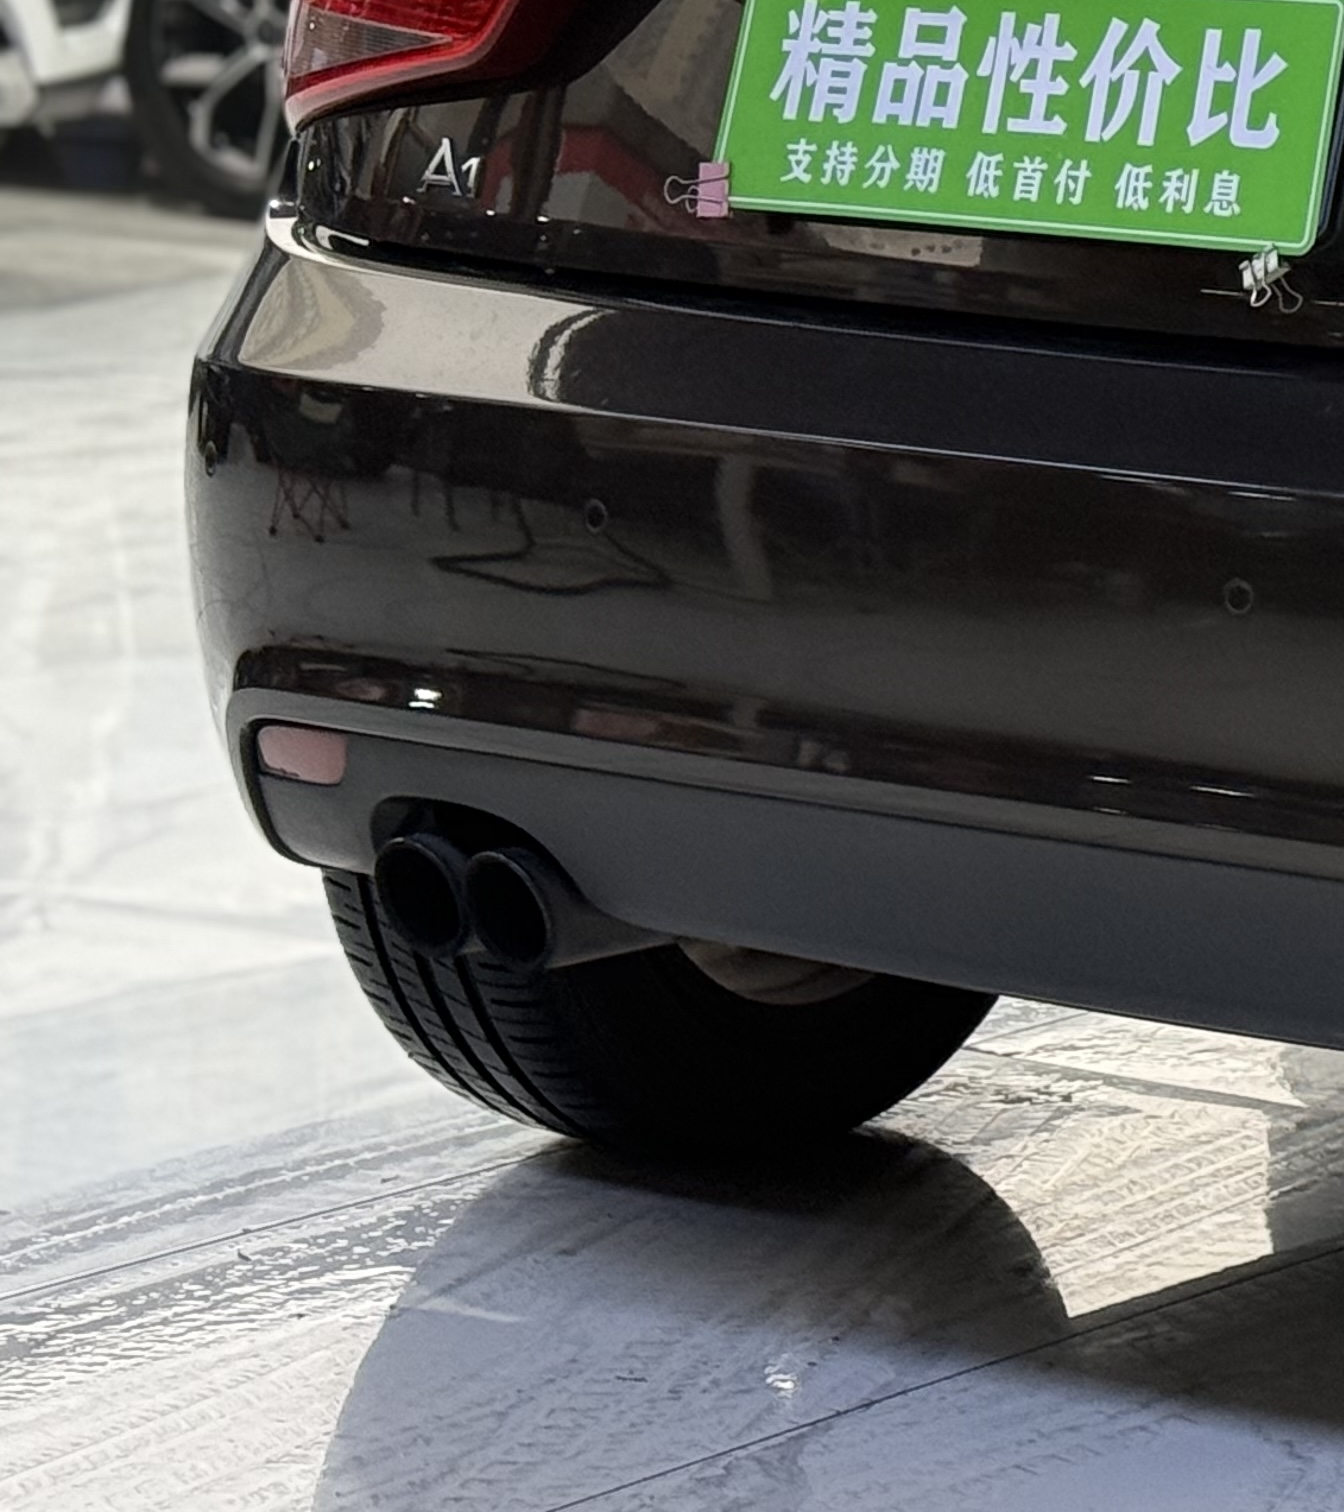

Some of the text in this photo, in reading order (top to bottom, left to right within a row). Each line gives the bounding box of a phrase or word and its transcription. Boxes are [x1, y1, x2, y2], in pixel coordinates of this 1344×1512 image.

[417, 137, 482, 199] A1
[780, 138, 1242, 218] 支持分期 低首付 低利息
